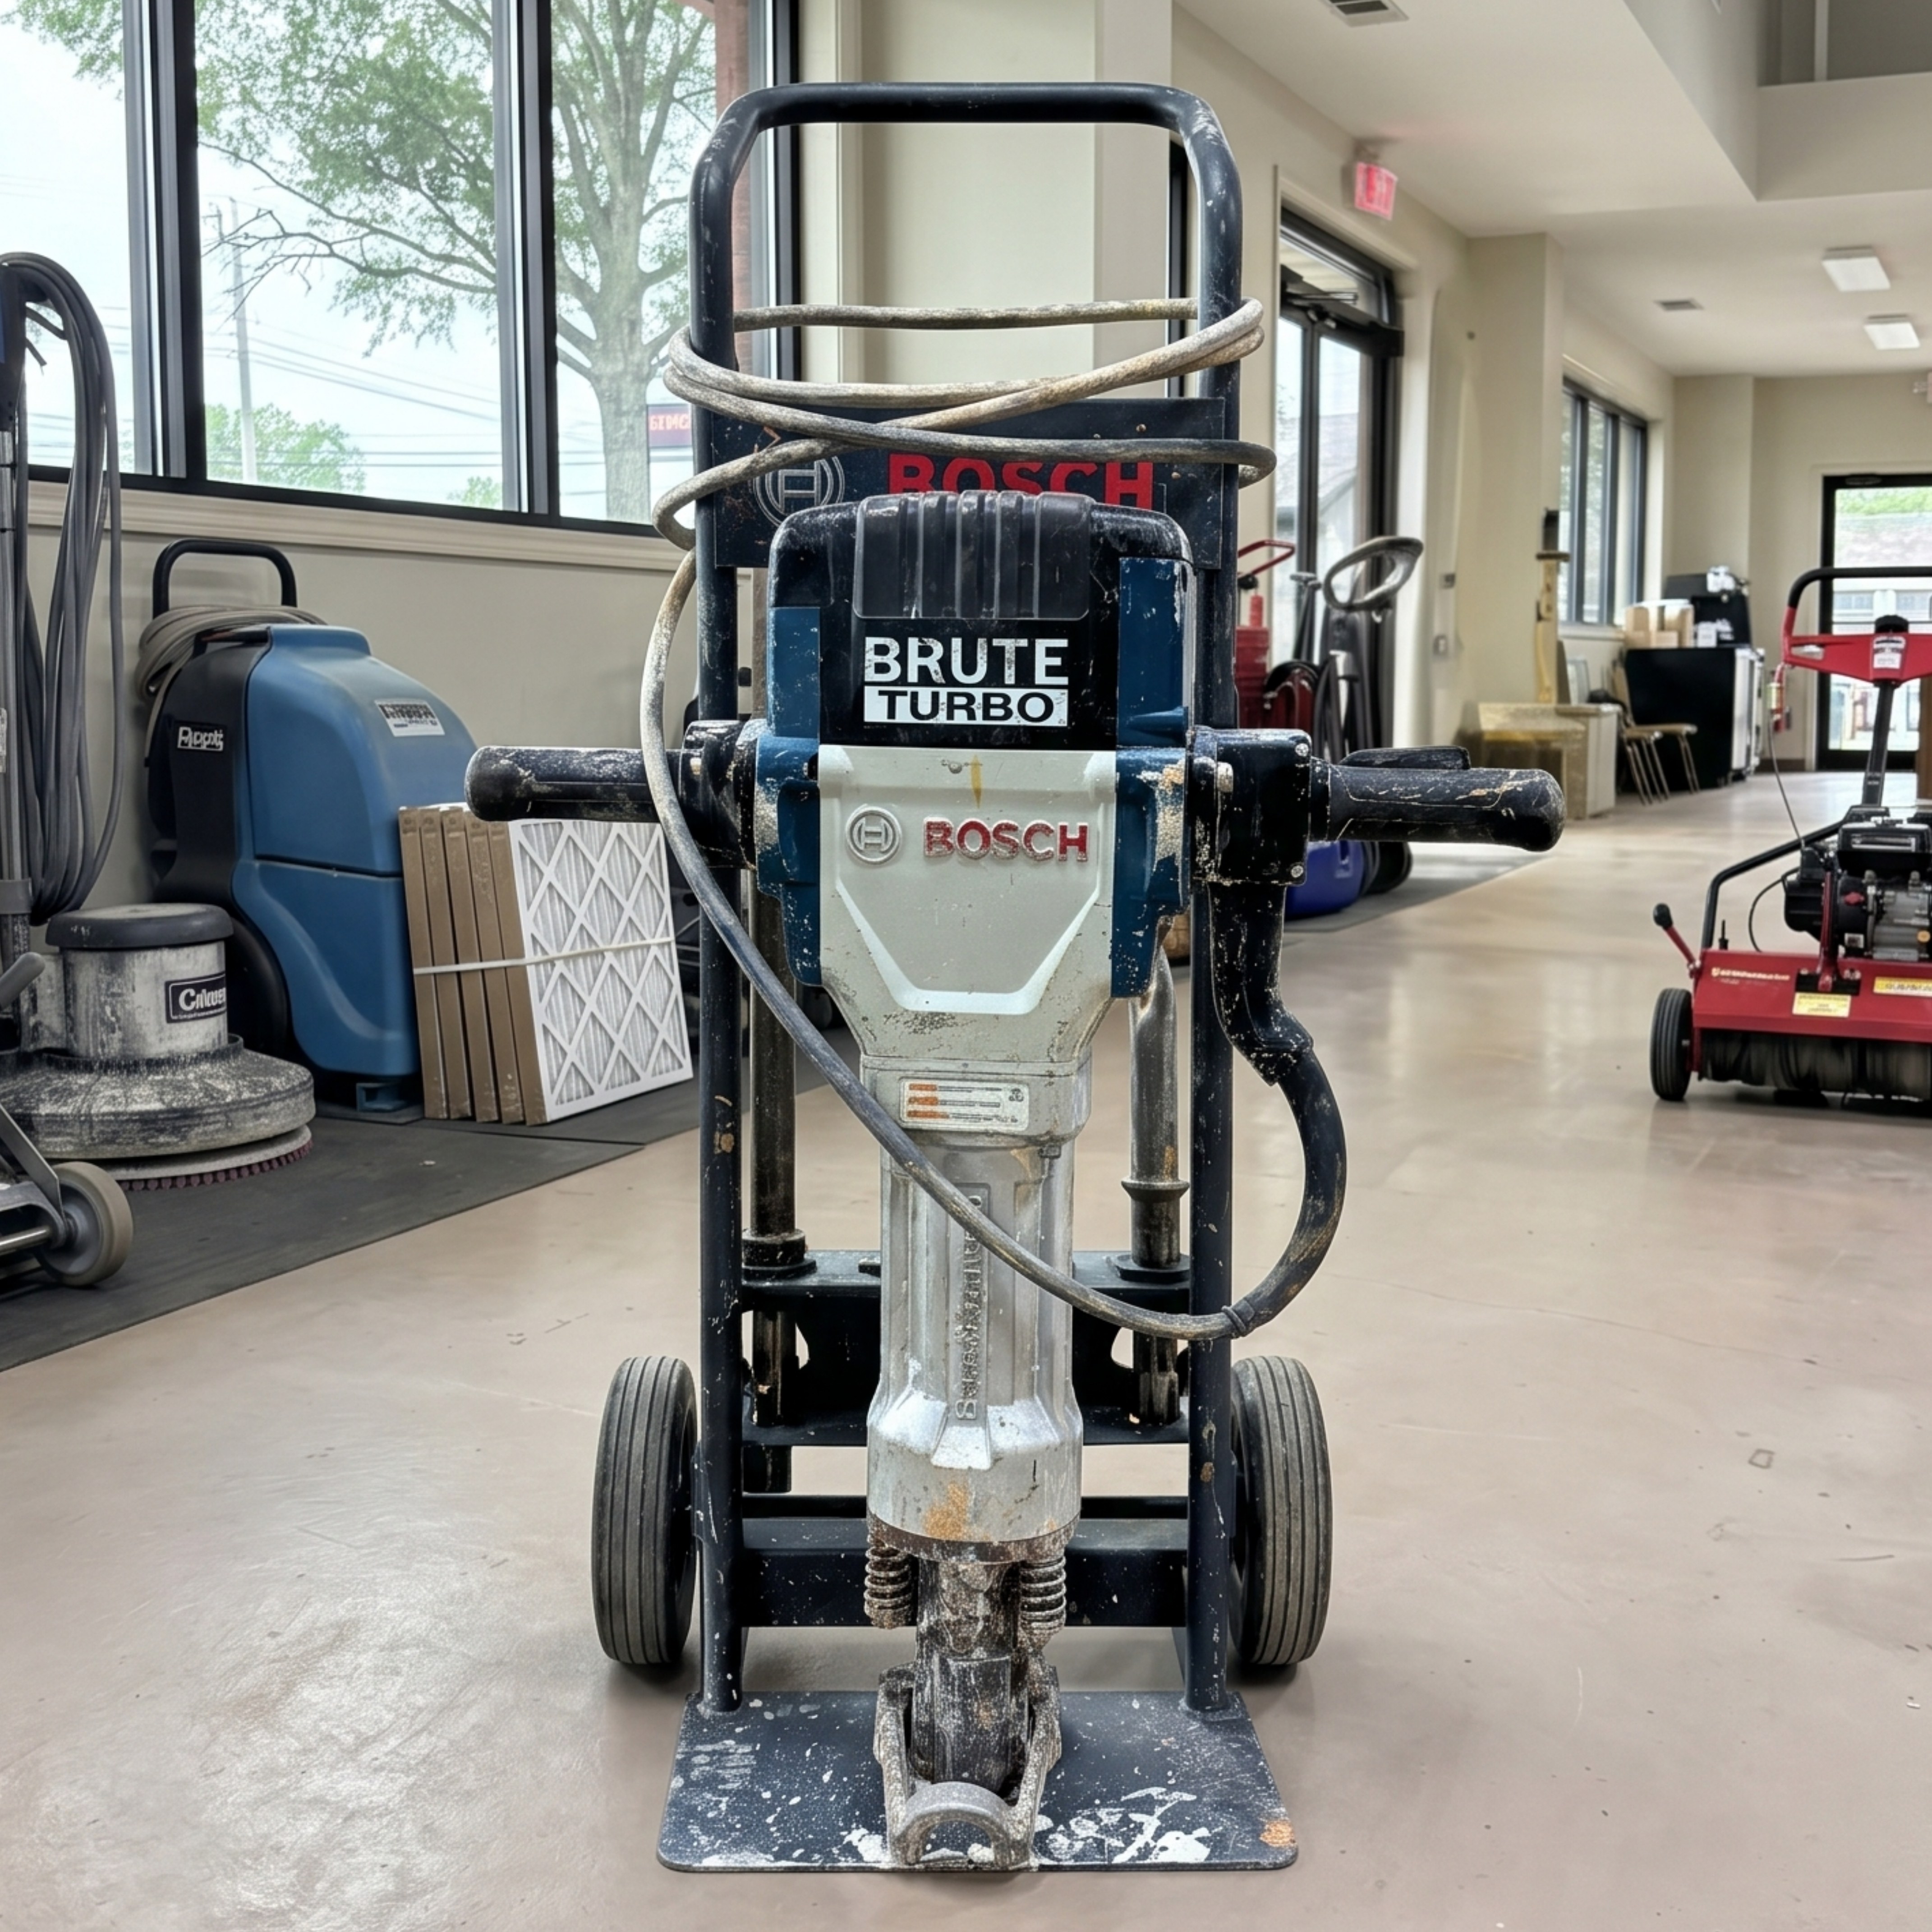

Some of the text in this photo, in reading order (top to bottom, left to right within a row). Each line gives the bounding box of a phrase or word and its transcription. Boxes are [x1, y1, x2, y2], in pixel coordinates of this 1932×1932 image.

[889, 453, 1153, 510] BOSCH
[865, 637, 1068, 685] BRUTE
[878, 690, 1054, 723] TURBO
[924, 817, 1088, 862] BOSCH
